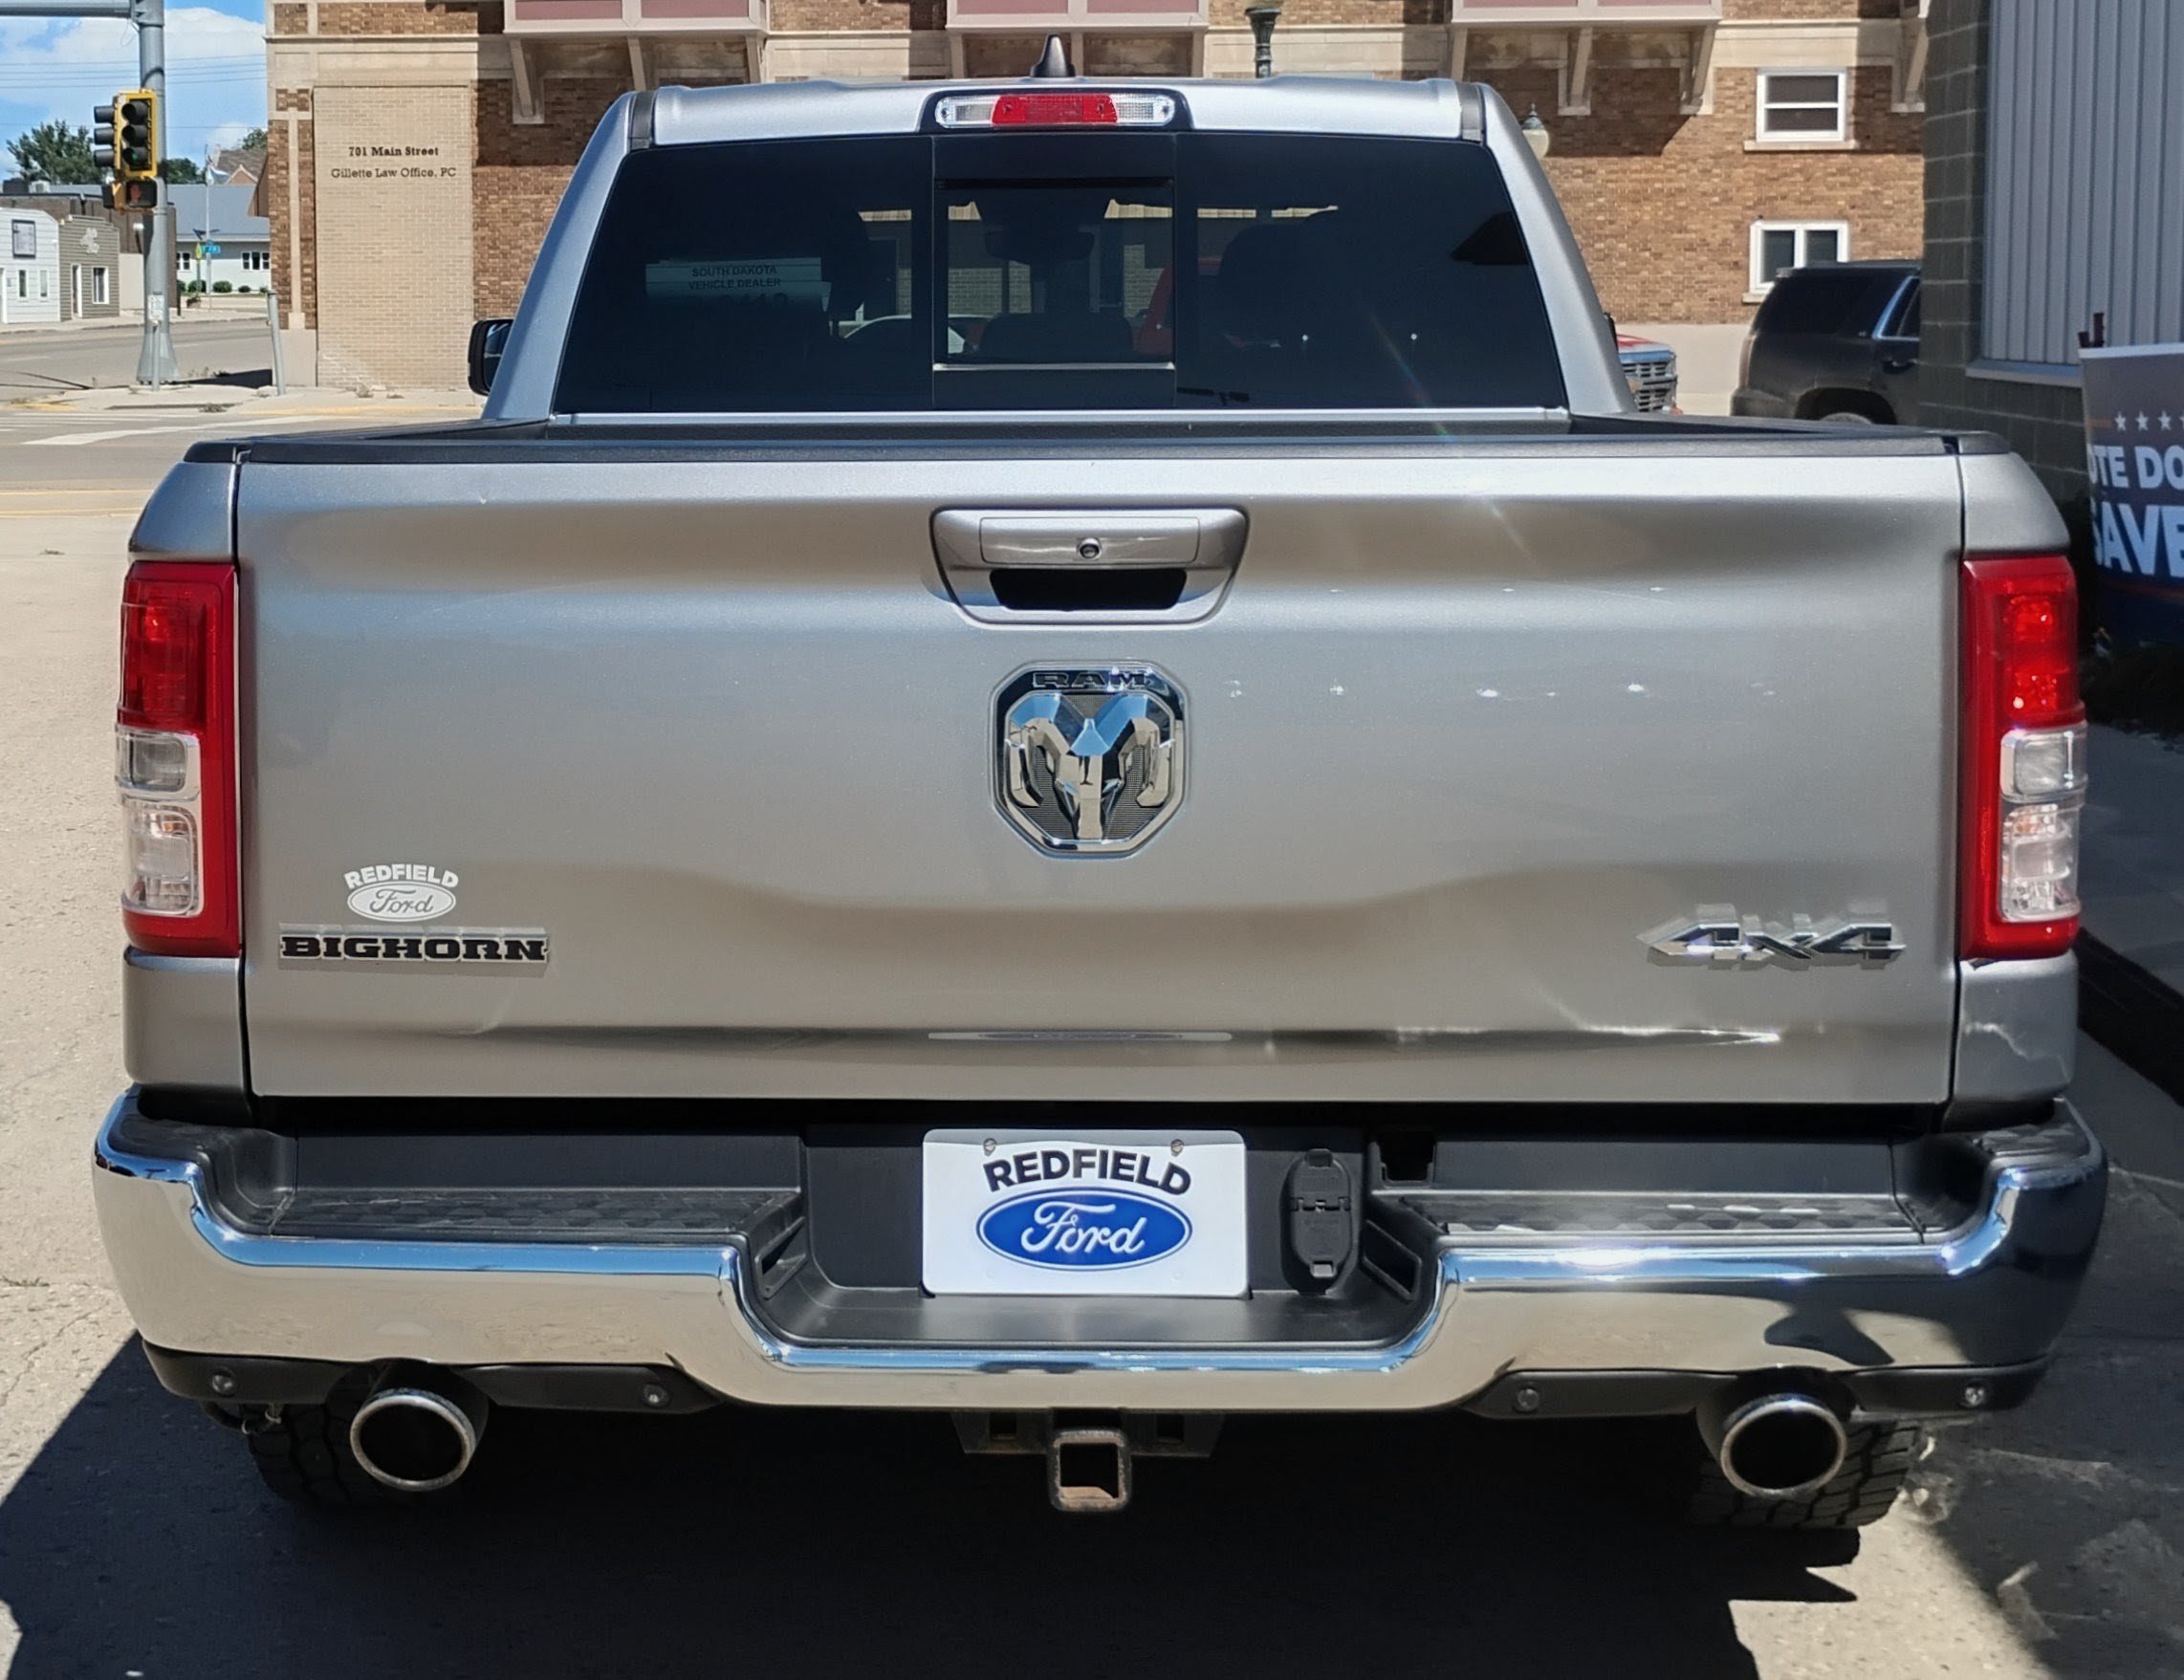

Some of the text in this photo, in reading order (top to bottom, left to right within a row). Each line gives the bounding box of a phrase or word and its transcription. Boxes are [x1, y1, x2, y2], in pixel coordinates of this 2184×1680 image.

[348, 146, 439, 157] 701 Main Street
[331, 167, 456, 178] Gillette Law Office, PC
[691, 265, 776, 277] SOUTH DAKOTA
[688, 277, 780, 291] VEHICLE DEALER
[1032, 669, 1147, 688] RAM
[343, 863, 459, 890] REDFIELD
[369, 887, 434, 914] Ford
[280, 933, 549, 963] BIGHORN
[983, 1148, 1191, 1196] REDFIELD
[1020, 1200, 1147, 1255] Ford
